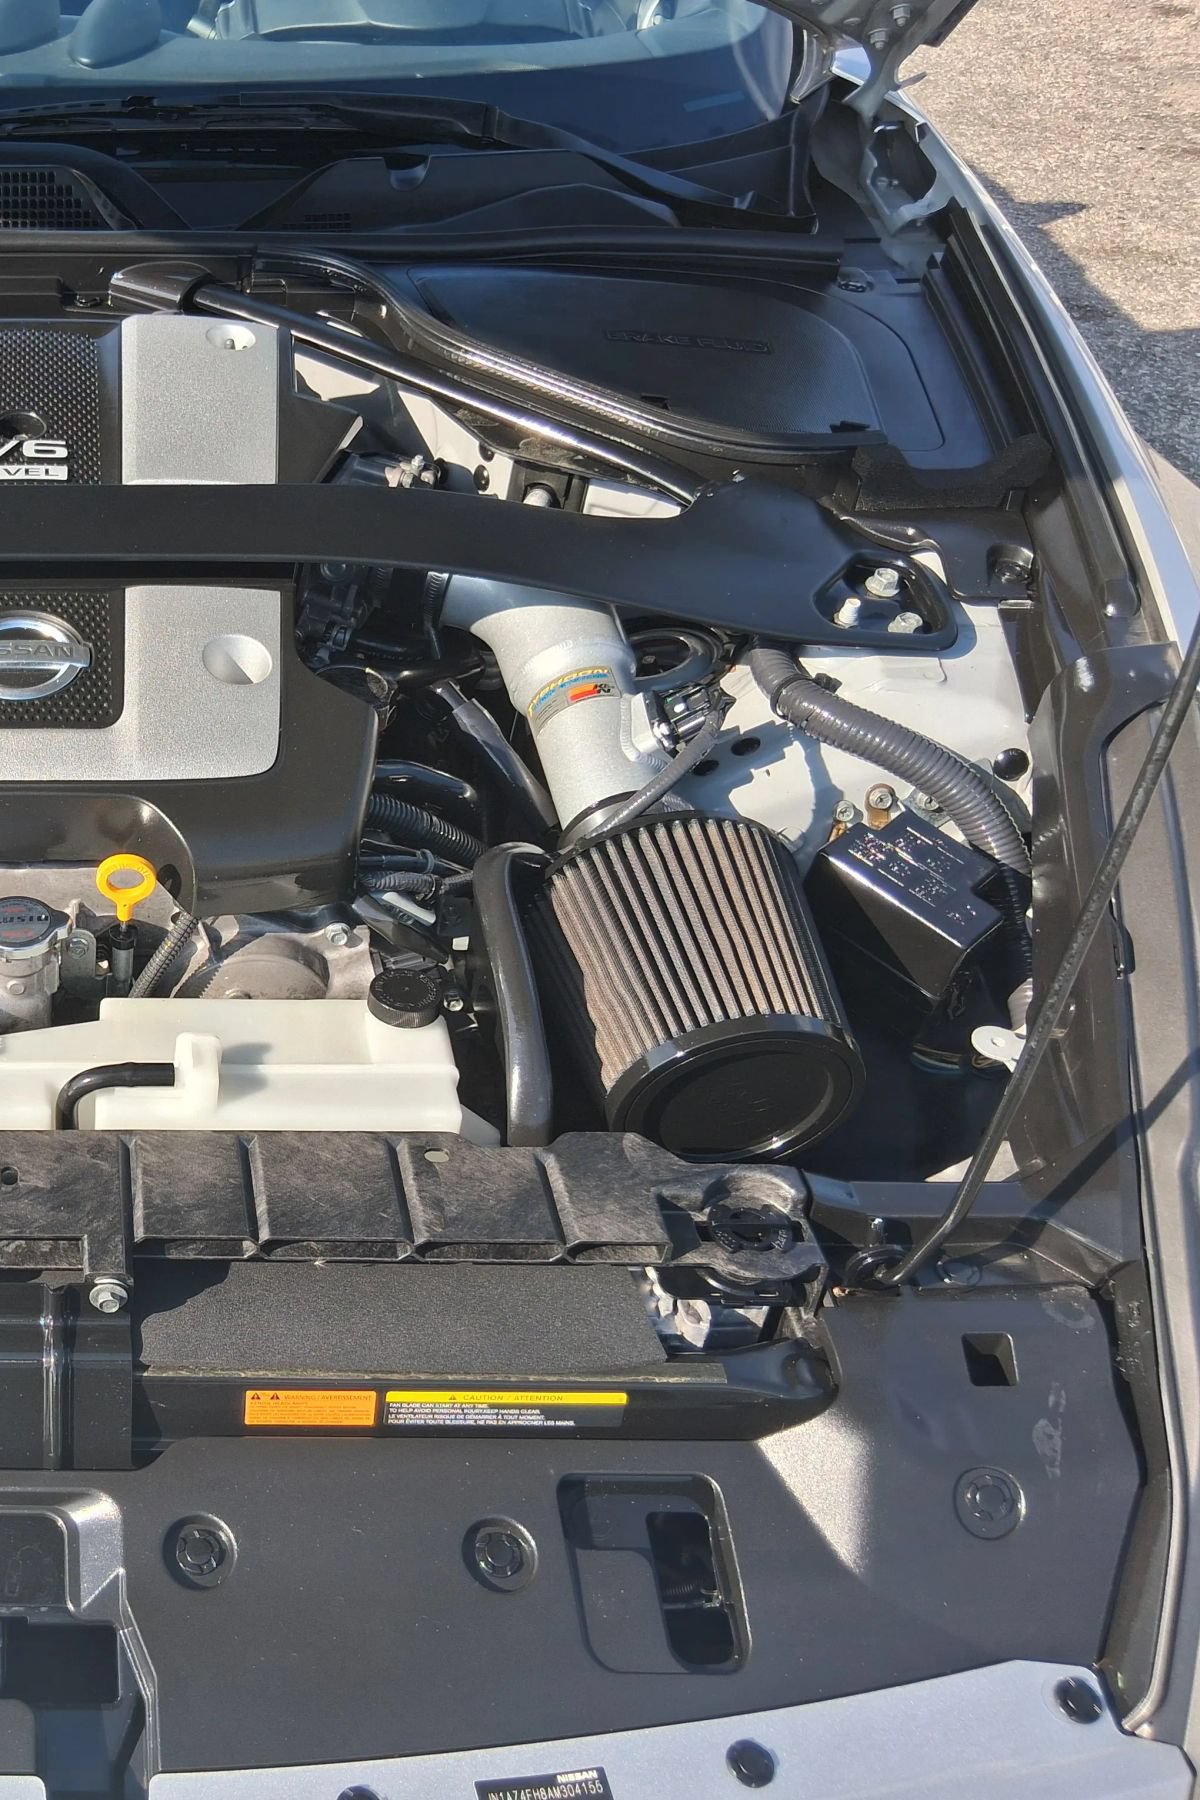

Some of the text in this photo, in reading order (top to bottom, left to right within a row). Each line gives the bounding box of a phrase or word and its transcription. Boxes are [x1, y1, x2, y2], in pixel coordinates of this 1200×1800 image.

[606, 329, 770, 353] BRAKE FLUID
[556, 1769, 598, 1784] NISSAN
